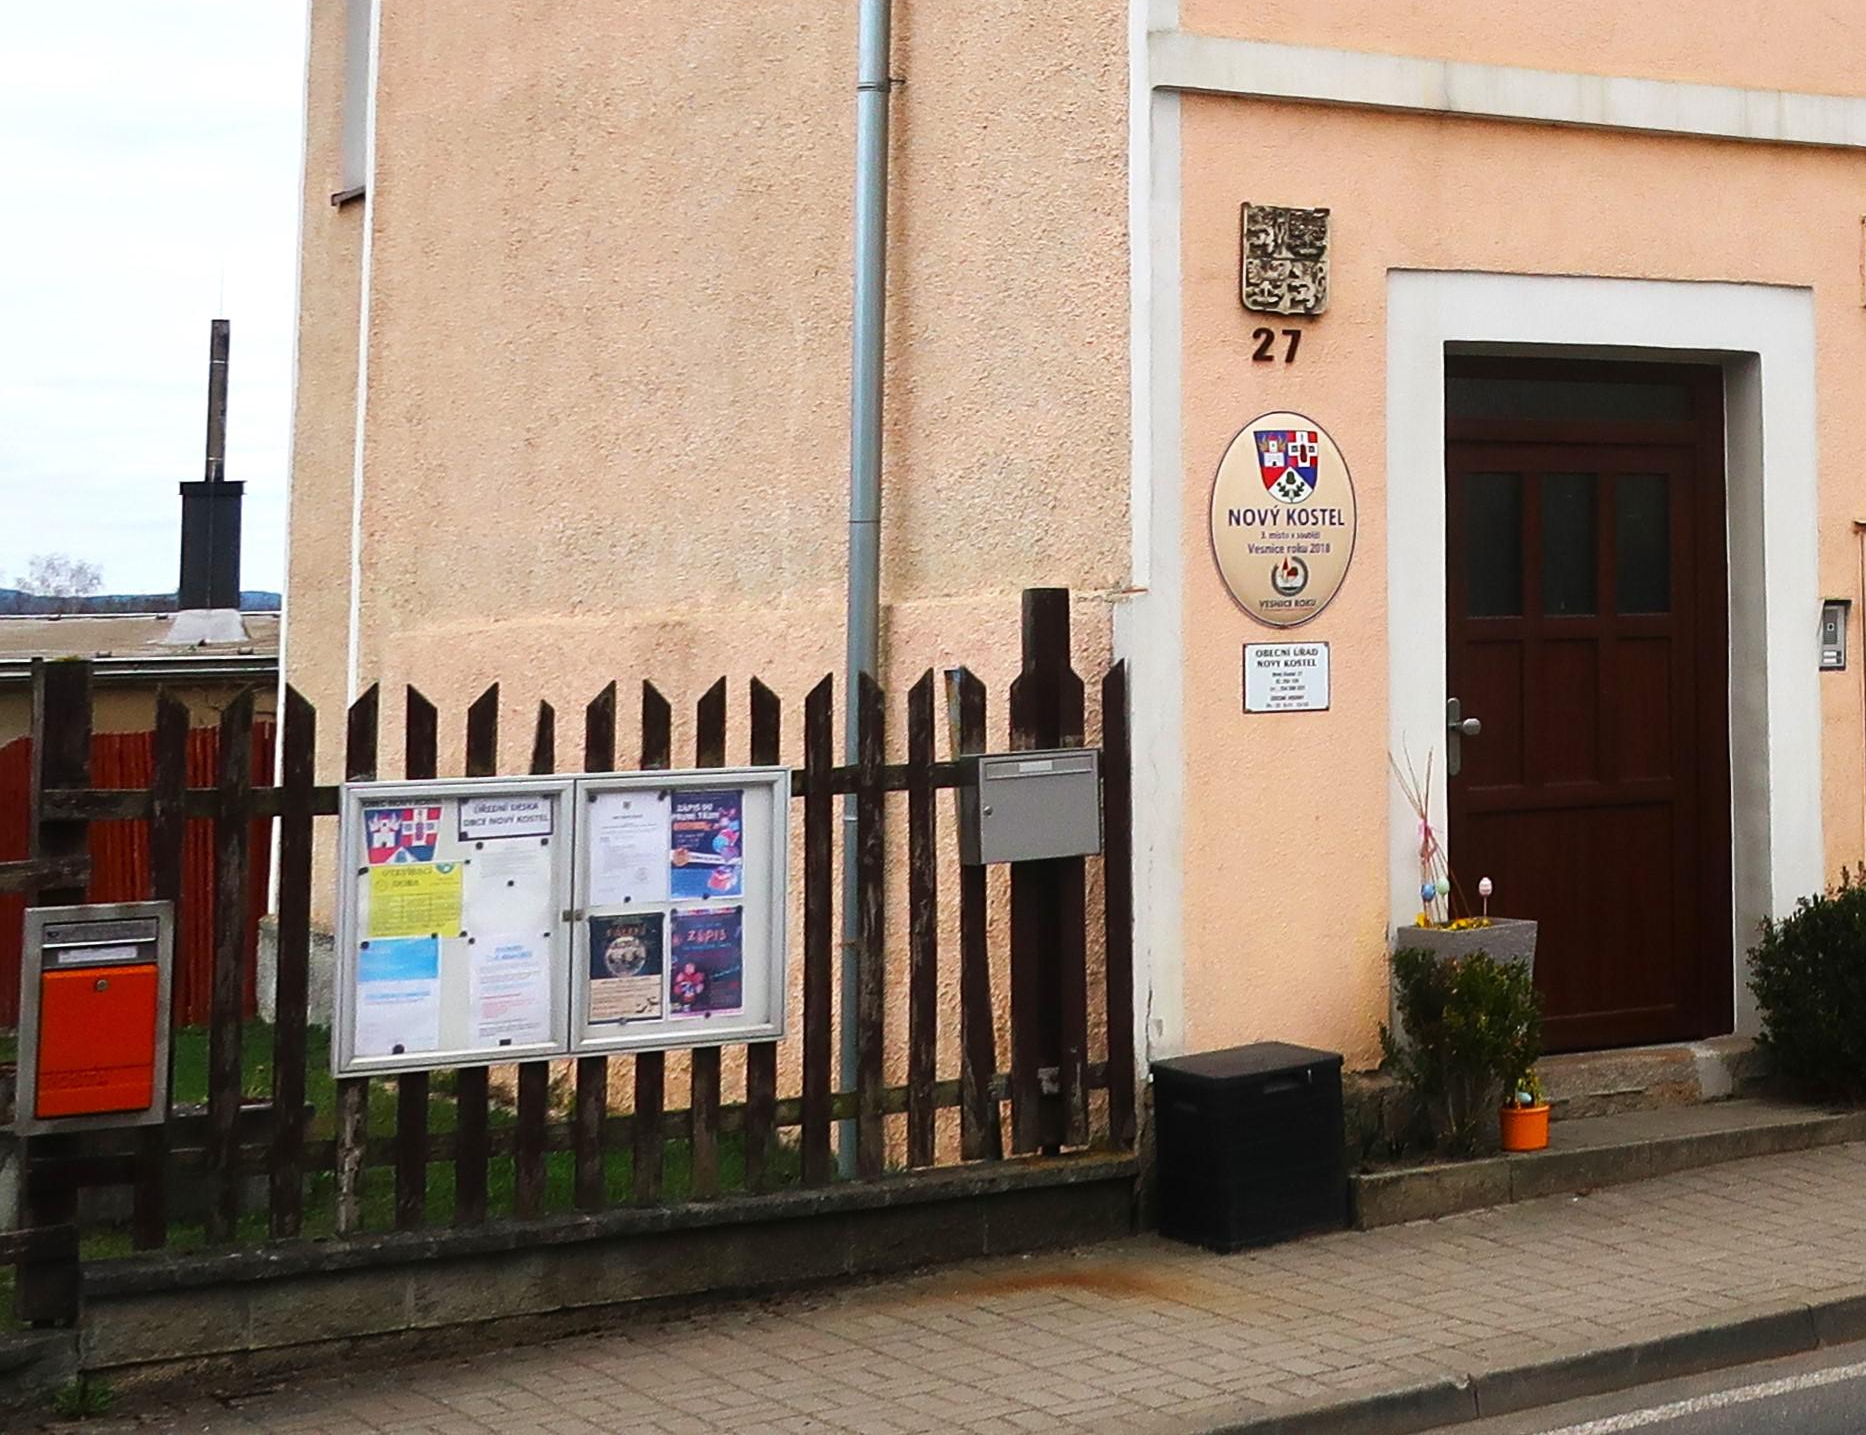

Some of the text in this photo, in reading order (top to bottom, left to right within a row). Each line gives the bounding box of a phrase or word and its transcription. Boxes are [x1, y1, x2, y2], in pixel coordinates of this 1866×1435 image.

[1252, 327, 1301, 363] 27
[1228, 505, 1345, 526] NOVÝ KOSTEL
[1248, 543, 1284, 554] Vesnice
[1287, 543, 1308, 553] roku
[1284, 659, 1317, 667] KOSTEL
